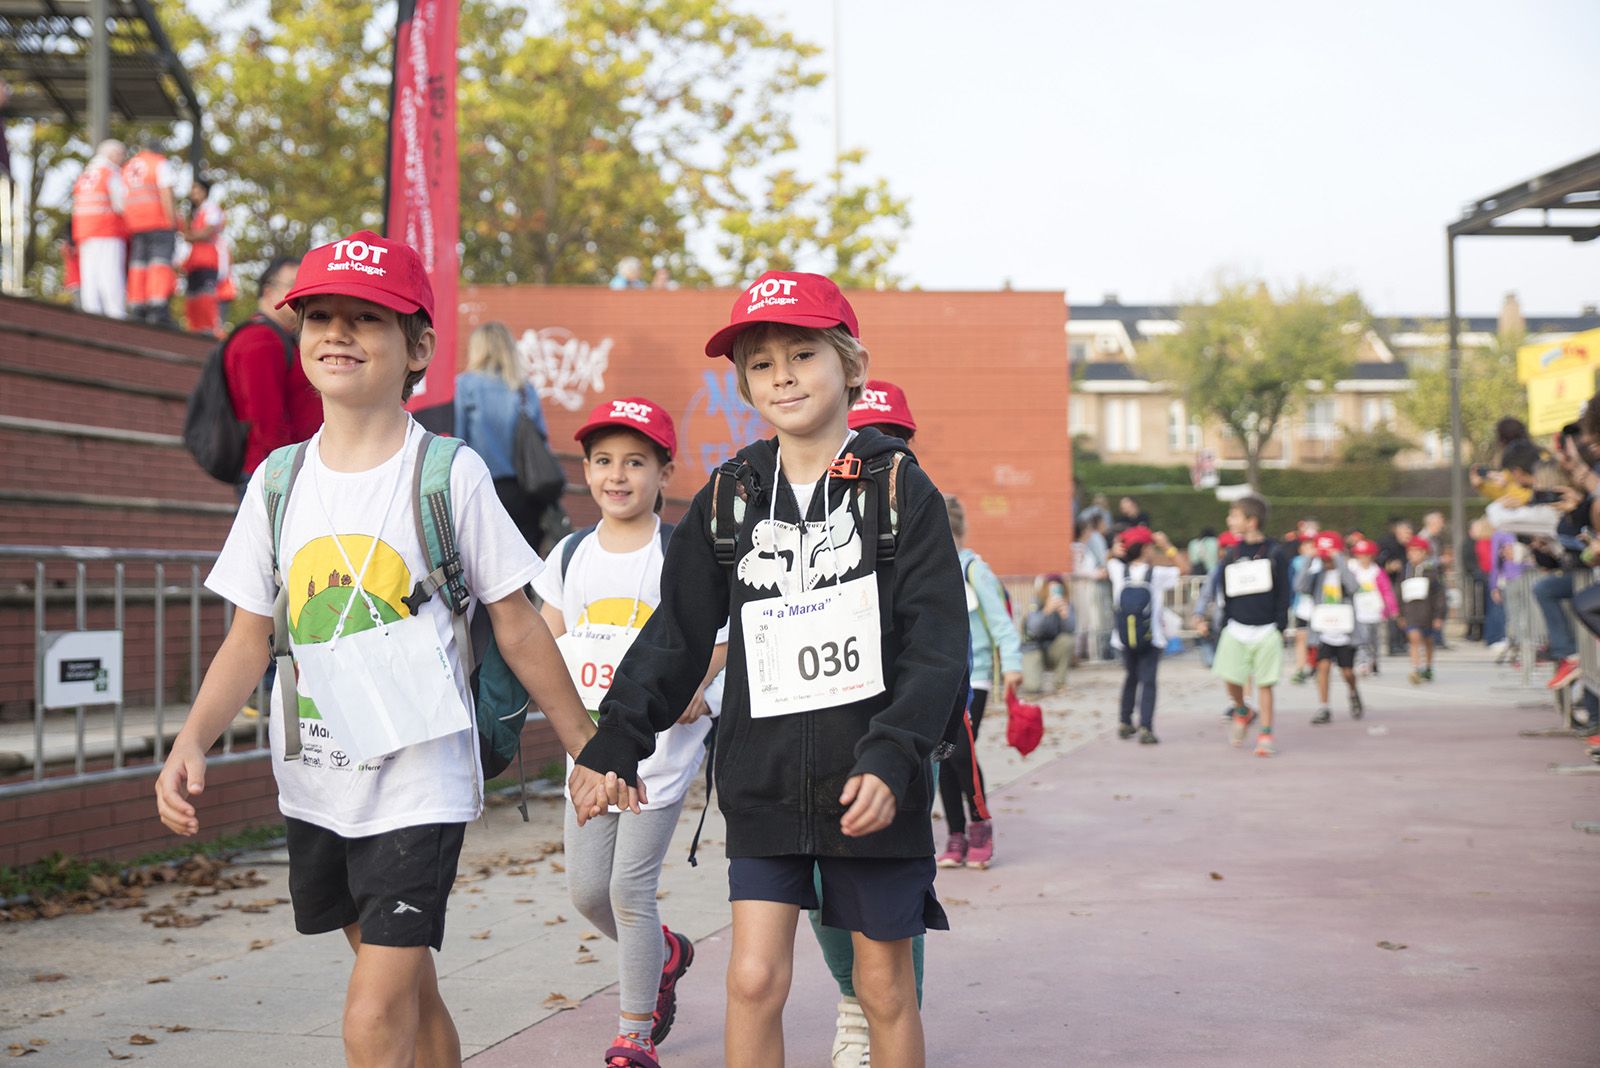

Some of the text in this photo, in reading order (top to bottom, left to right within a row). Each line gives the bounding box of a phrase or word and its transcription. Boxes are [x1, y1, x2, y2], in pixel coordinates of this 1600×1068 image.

[332, 240, 388, 264] TOT
[354, 262, 386, 276] Cugat
[749, 278, 797, 303] TOT
[862, 389, 888, 404] OT
[612, 400, 652, 416] TOT
[788, 598, 831, 616] Marxa”
[797, 635, 861, 681] 036
[580, 661, 615, 689] 03
